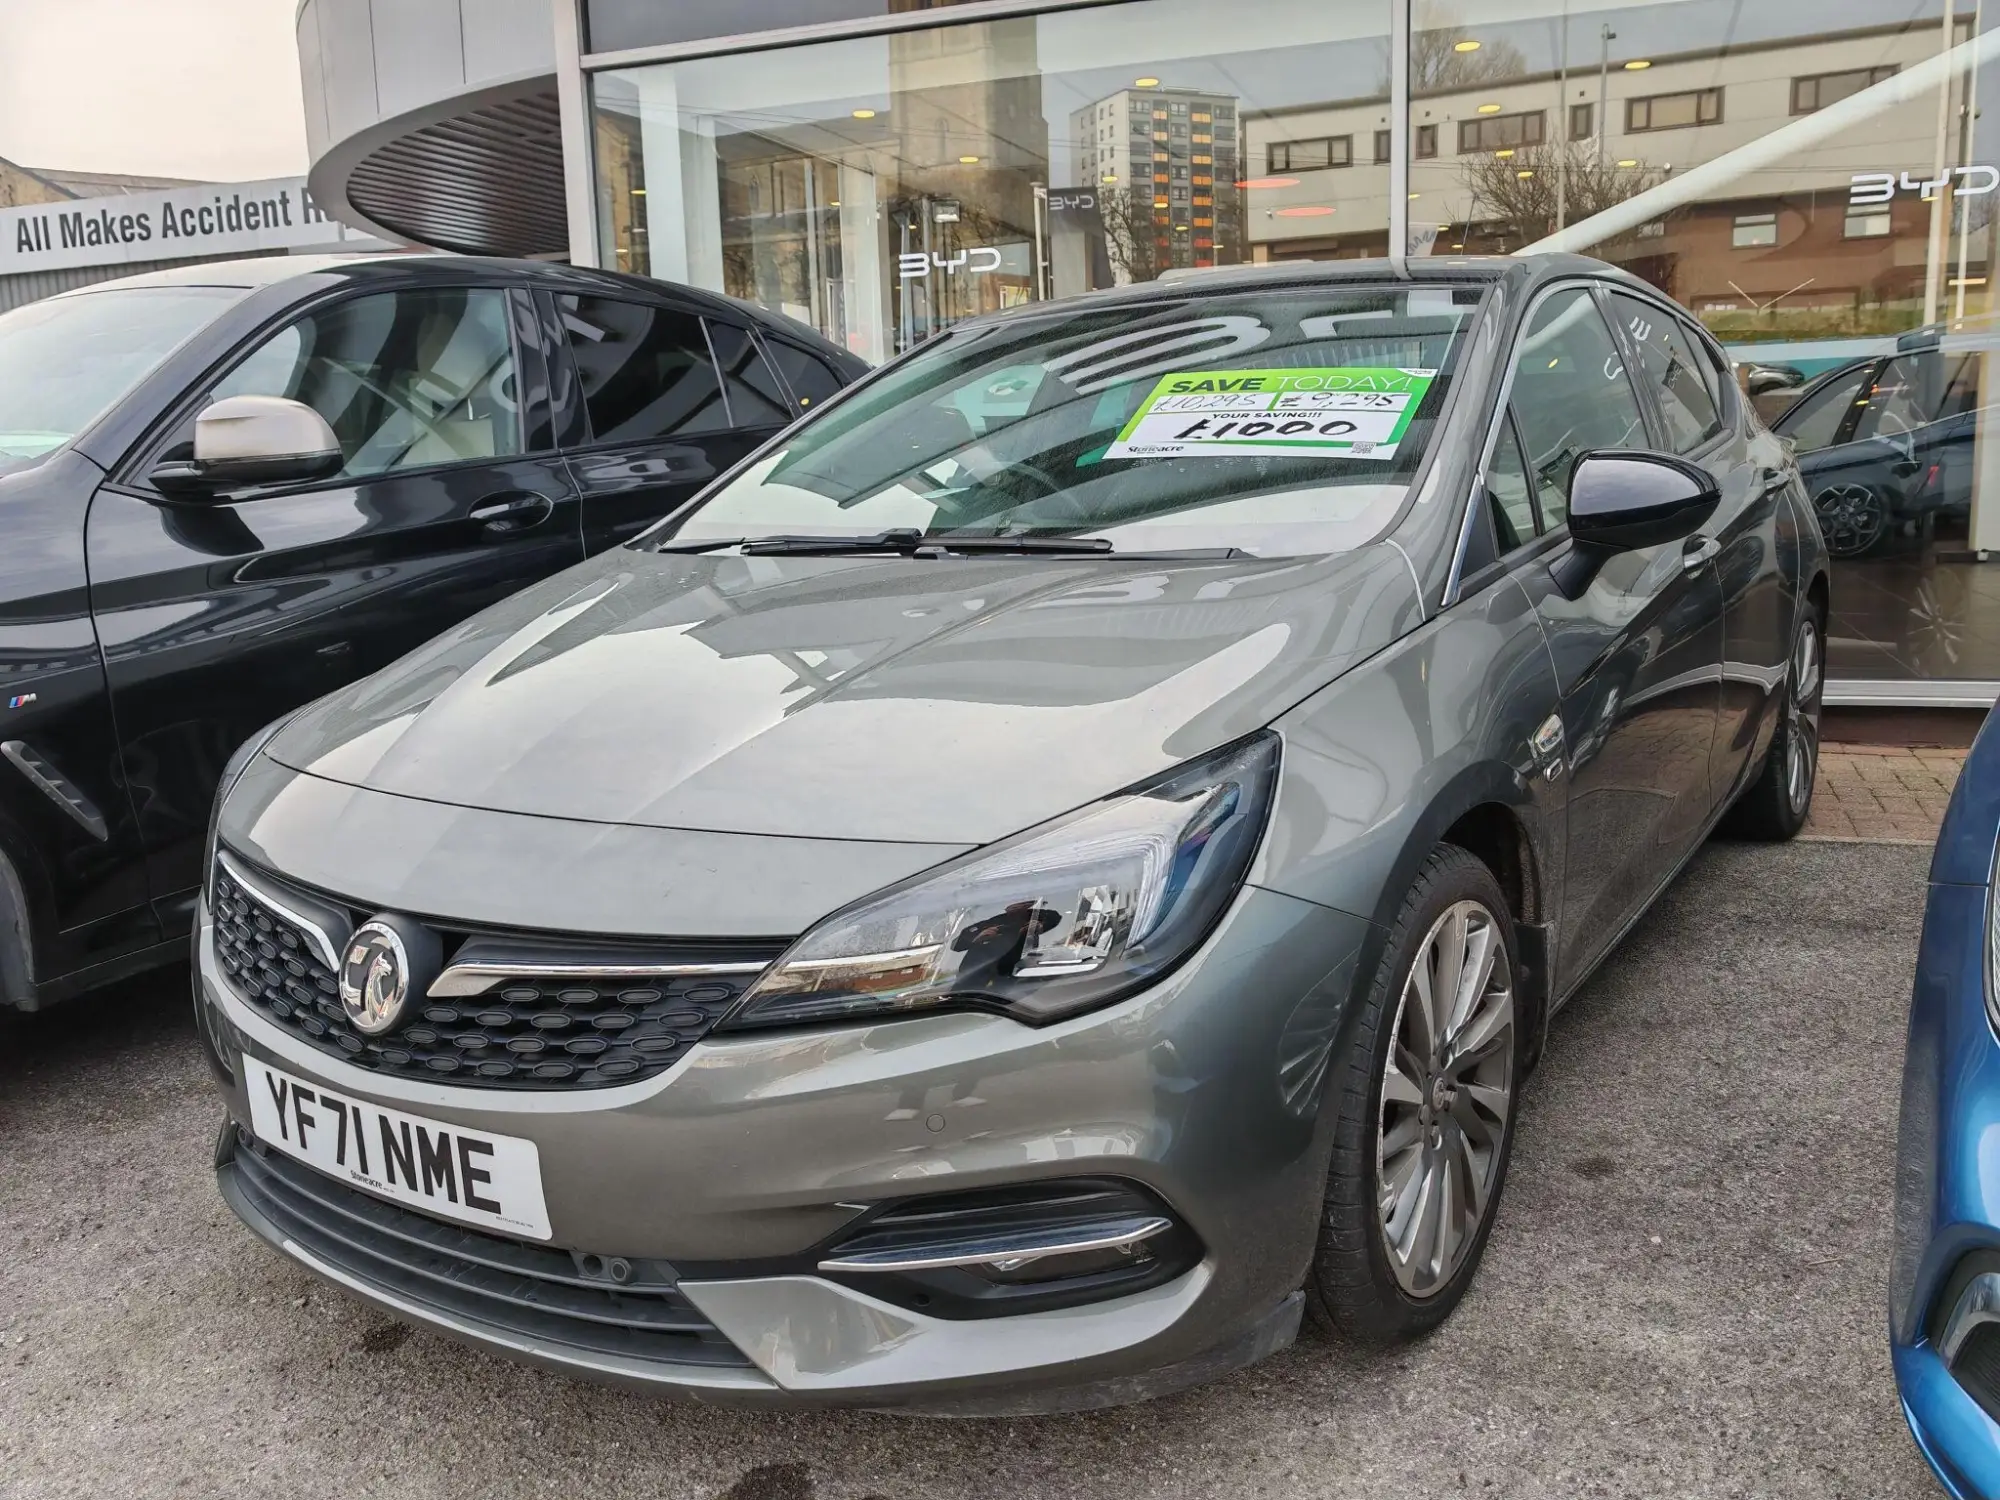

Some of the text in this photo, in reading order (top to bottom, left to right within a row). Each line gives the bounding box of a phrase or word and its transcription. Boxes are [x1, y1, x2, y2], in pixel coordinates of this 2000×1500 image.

[1850, 165, 2000, 204] BYD
[1049, 194, 1095, 211] BYD
[17, 213, 51, 253] All
[59, 208, 152, 249] Makes
[161, 190, 293, 239] Accident
[899, 247, 1002, 278] BYD
[1168, 375, 1413, 393] SAVE TODAY!
[1173, 418, 1358, 440] £1000
[265, 1071, 502, 1215] YF71 NME
